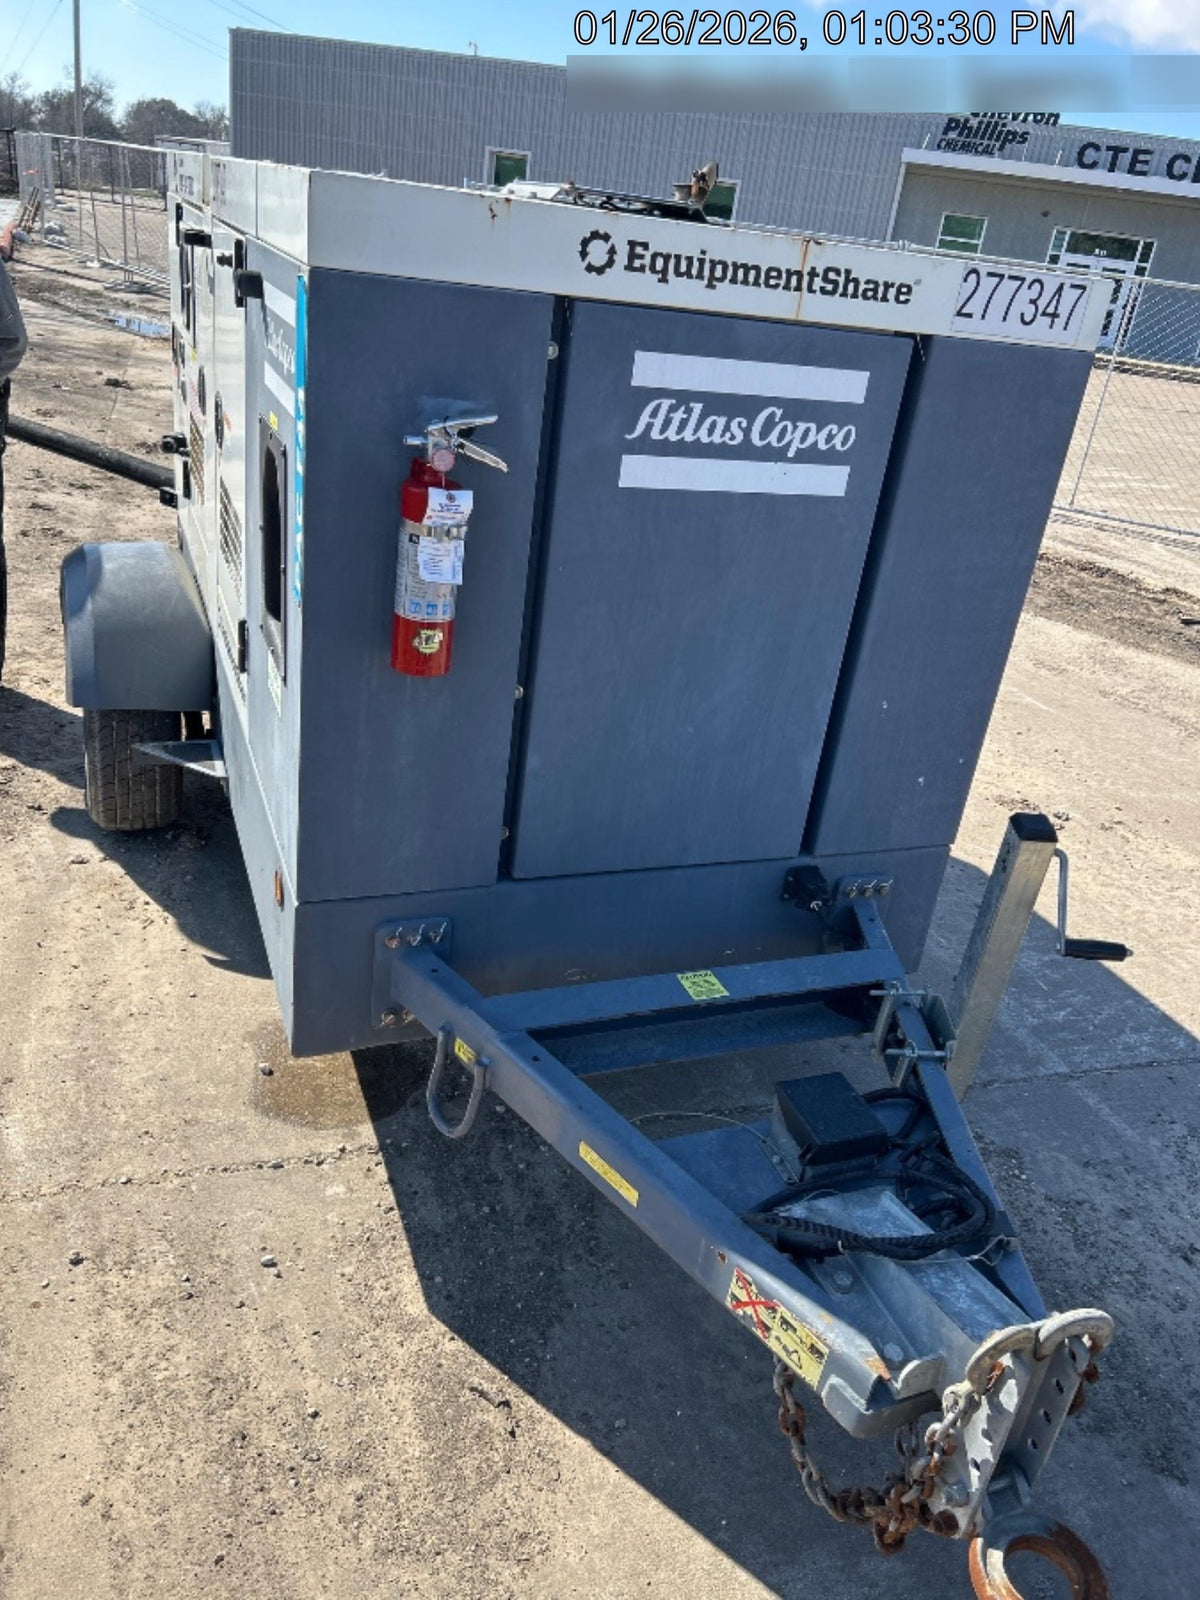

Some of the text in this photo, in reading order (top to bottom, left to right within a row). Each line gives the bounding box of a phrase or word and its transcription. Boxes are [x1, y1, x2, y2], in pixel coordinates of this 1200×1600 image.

[937, 138, 997, 155] CHEMICAL
[942, 117, 1030, 151] Phillips
[1077, 142, 1154, 176] CTE
[624, 239, 912, 305] EquipmentShare
[955, 267, 1087, 331] 277347
[625, 398, 856, 458] Atlas Copco
